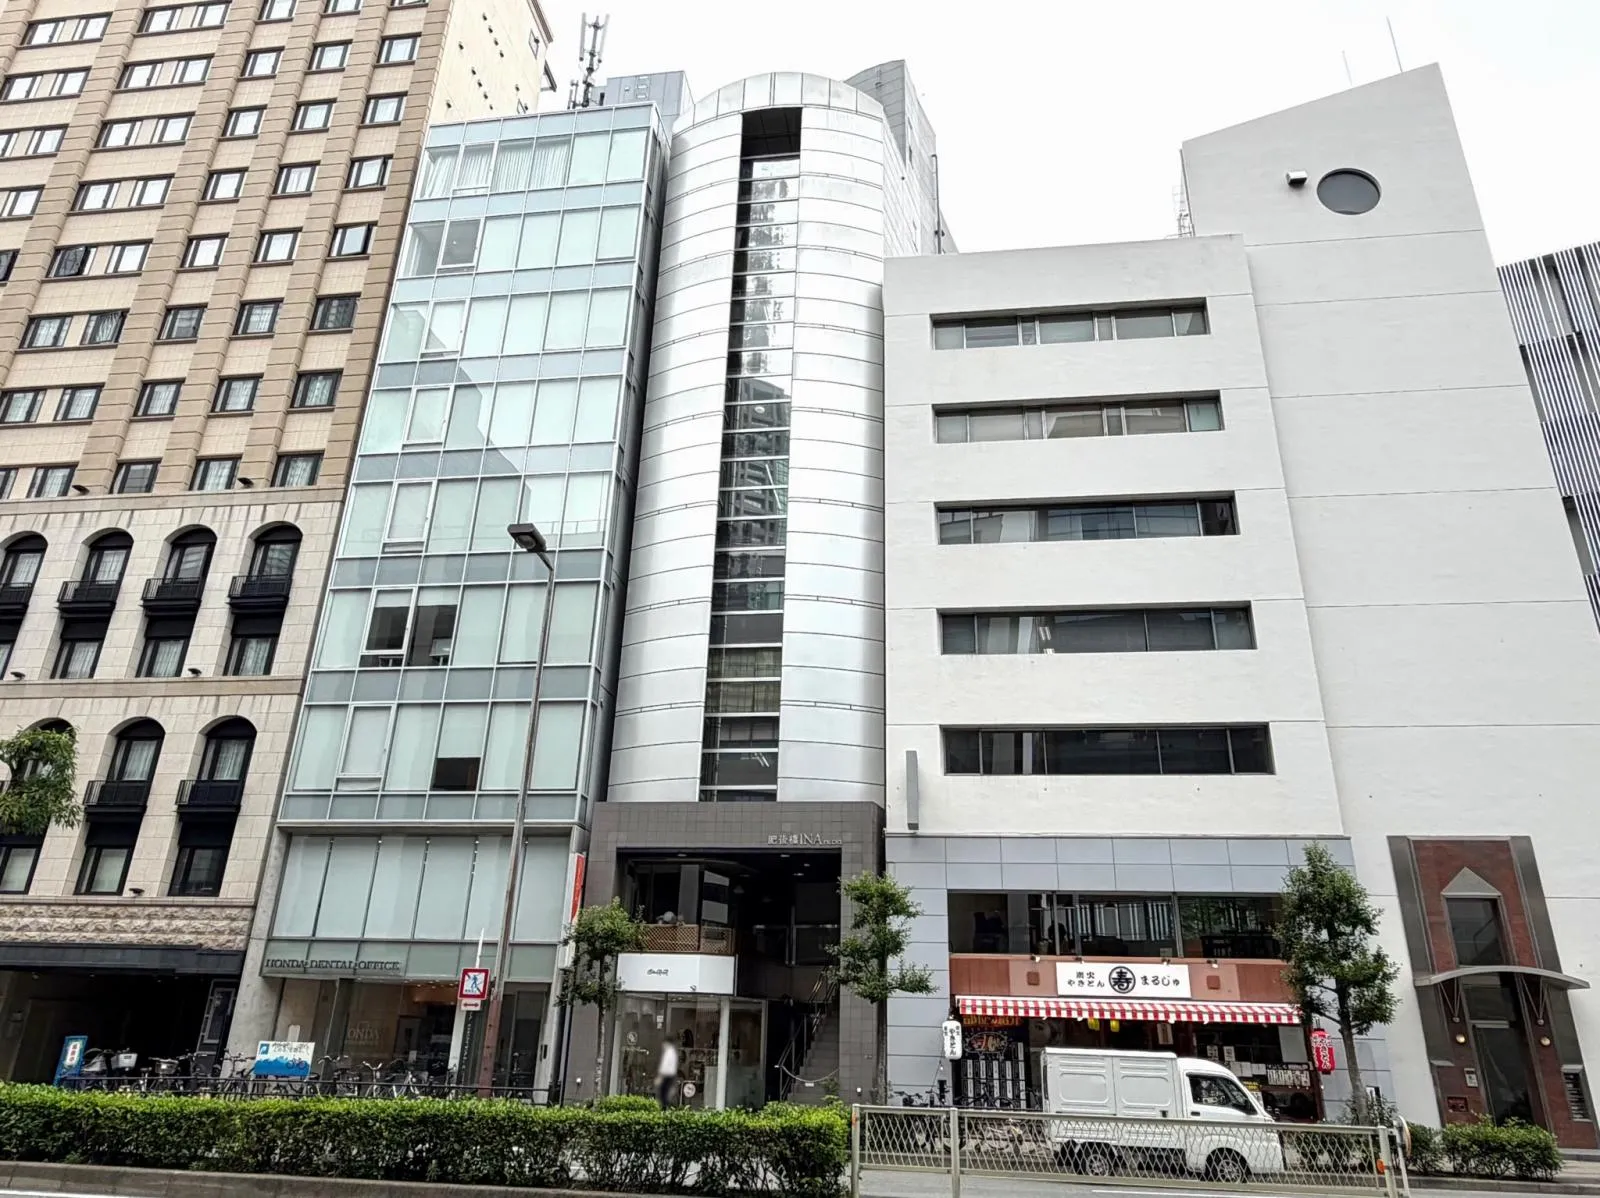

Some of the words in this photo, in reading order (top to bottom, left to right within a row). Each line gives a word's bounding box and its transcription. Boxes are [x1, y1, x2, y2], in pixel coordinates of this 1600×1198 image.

[264, 959, 305, 968] HONDA
[309, 960, 354, 969] DENTAL
[358, 961, 400, 971] OFFICE
[1067, 979, 1105, 988] やきとん
[1140, 975, 1180, 987] まるじゅ
